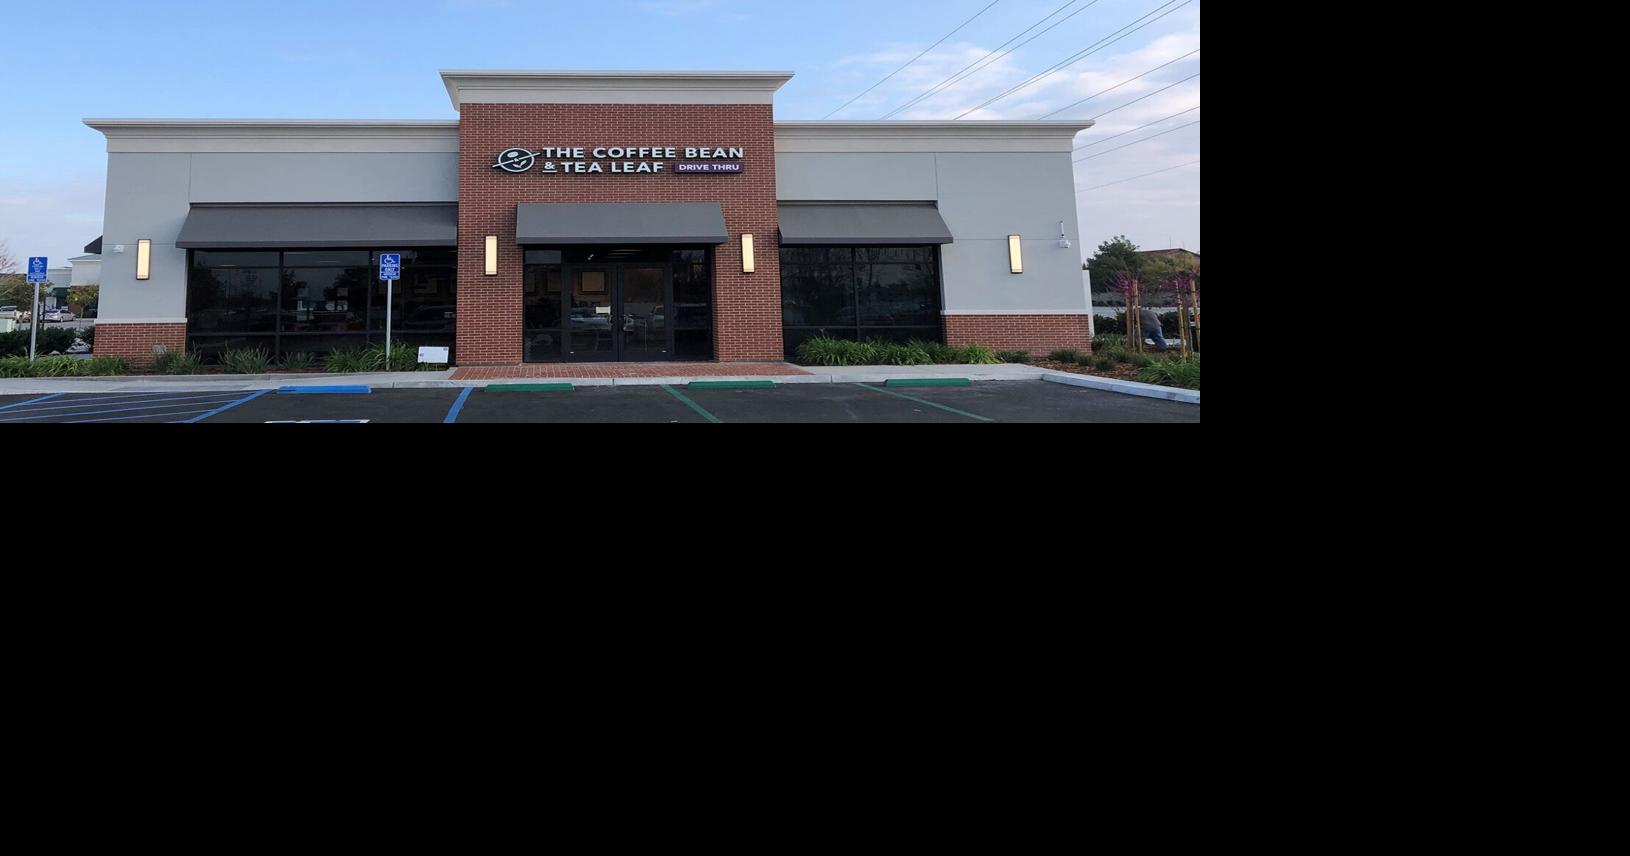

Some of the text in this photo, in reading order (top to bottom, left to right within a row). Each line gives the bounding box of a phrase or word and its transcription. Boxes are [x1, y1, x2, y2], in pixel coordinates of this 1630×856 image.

[542, 147, 744, 158] THE COFFEE BEAN
[543, 162, 664, 173] & TEA LEAF
